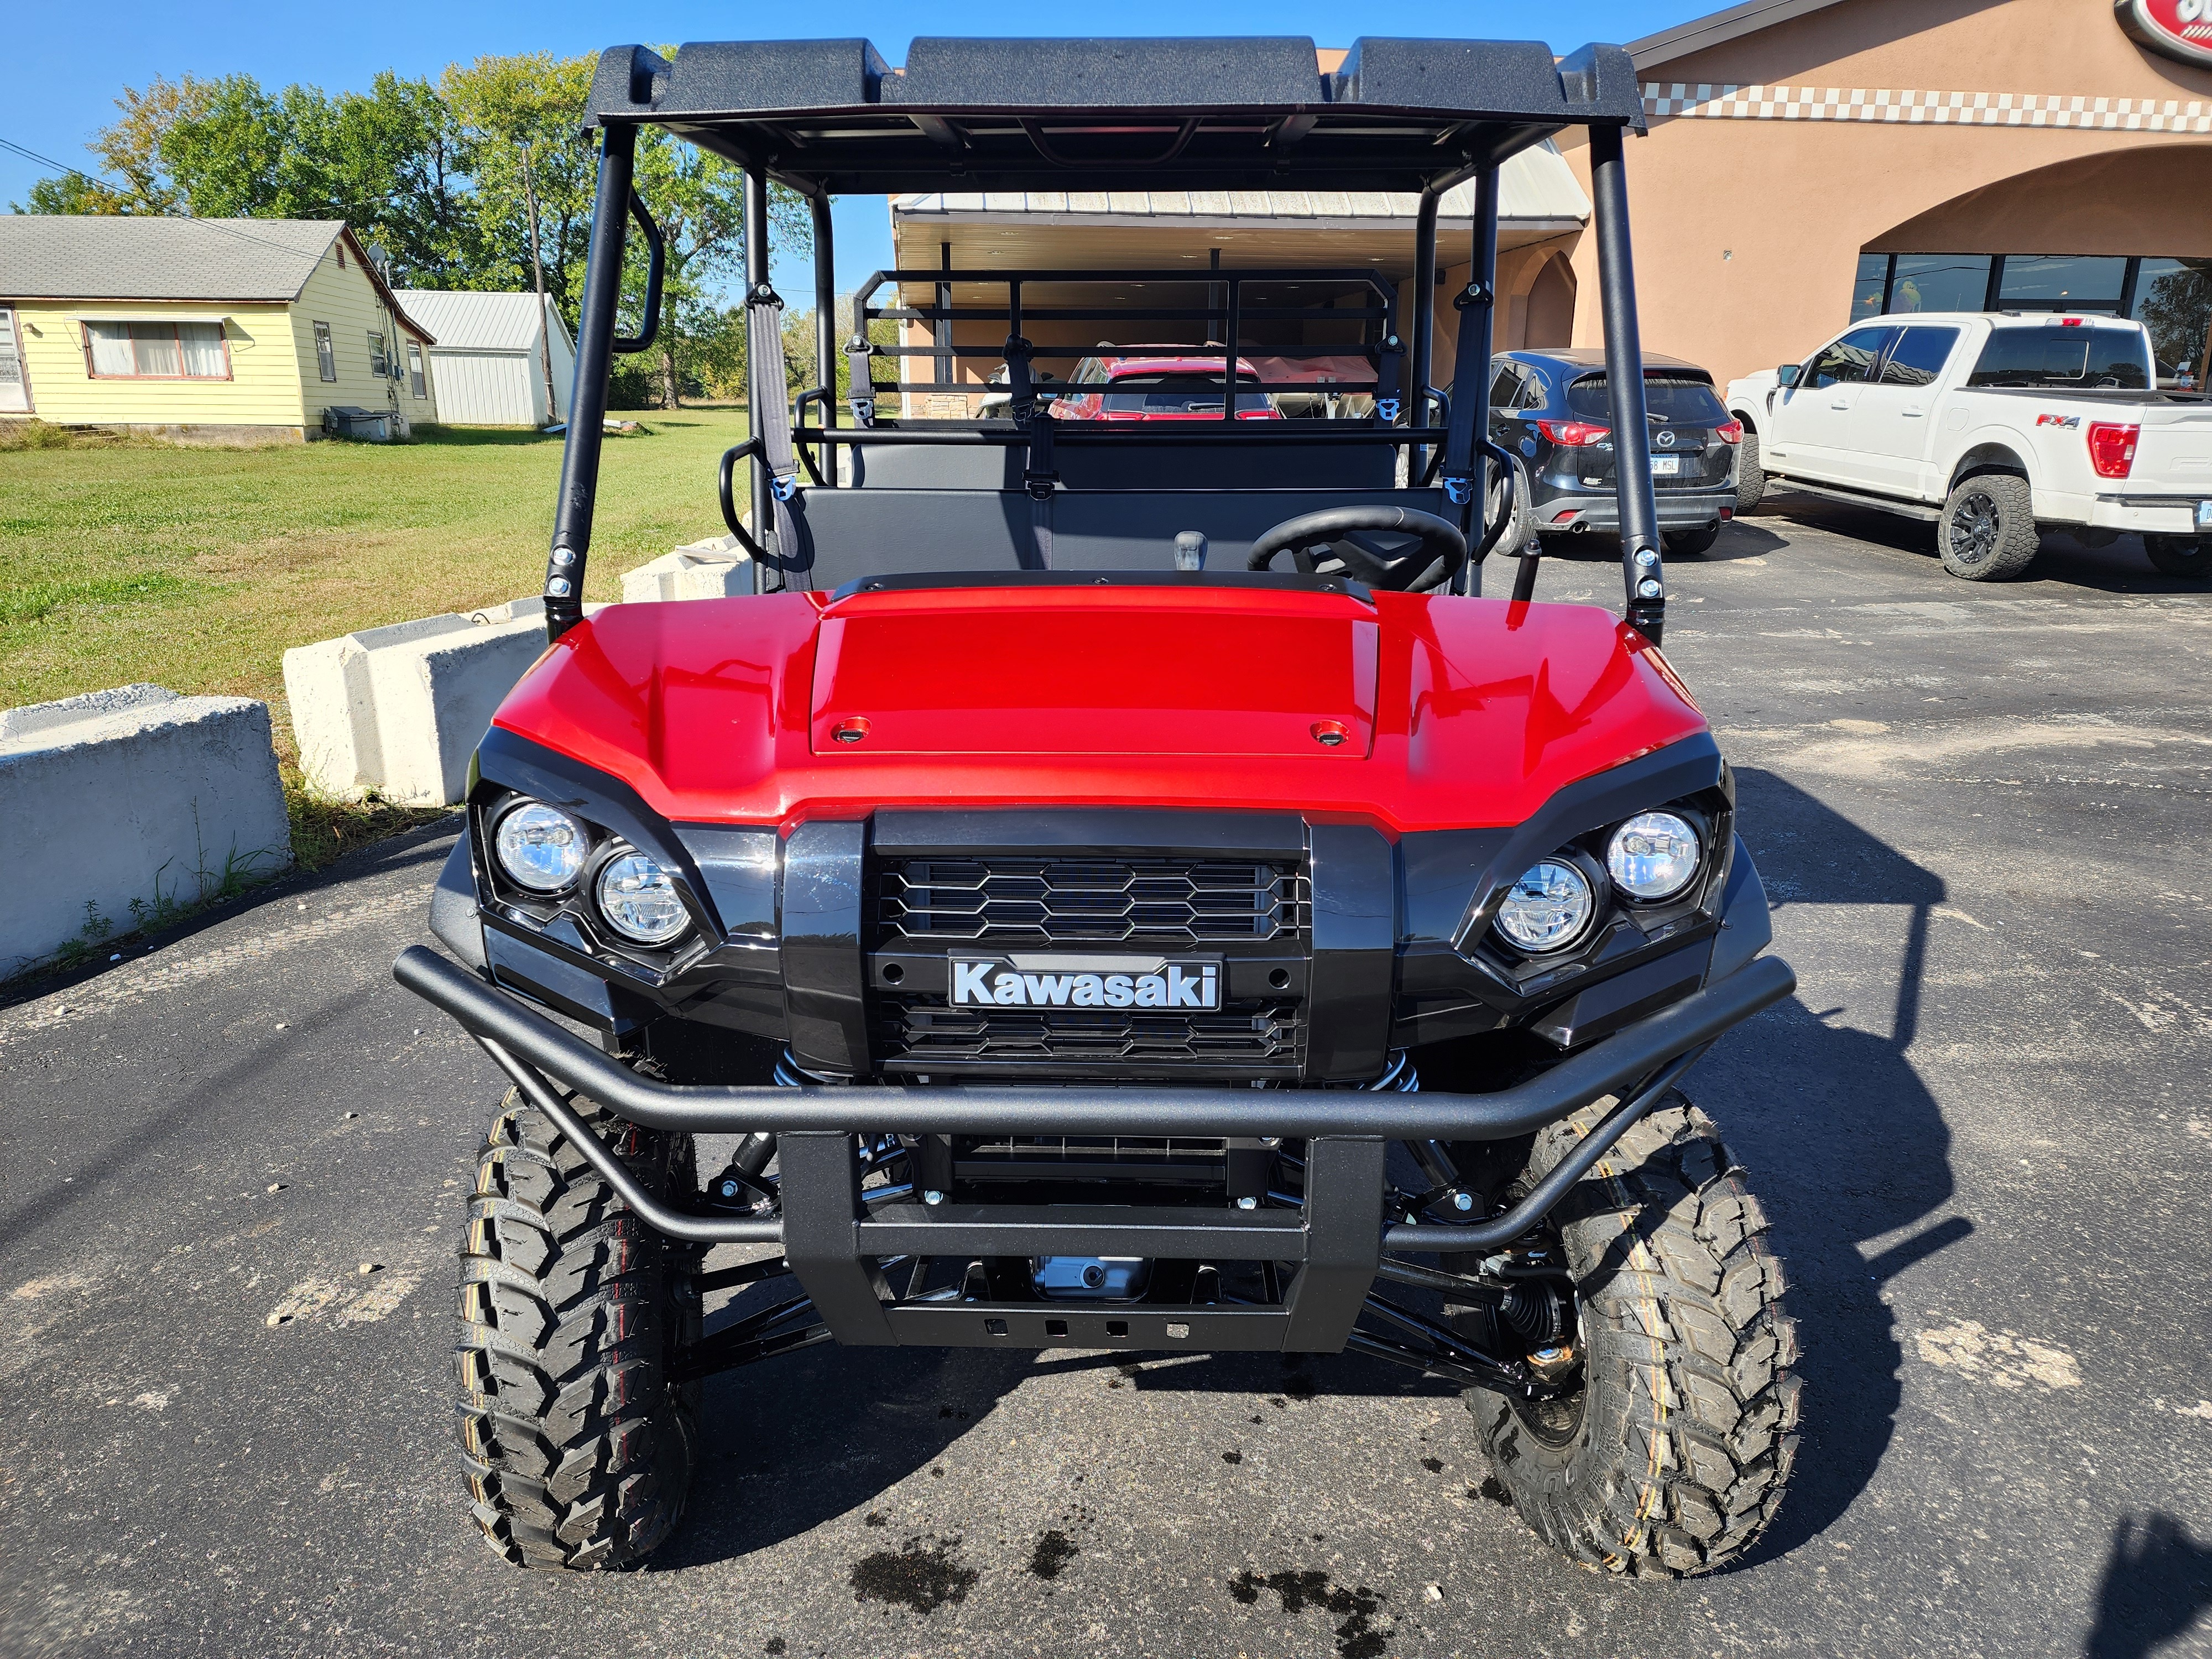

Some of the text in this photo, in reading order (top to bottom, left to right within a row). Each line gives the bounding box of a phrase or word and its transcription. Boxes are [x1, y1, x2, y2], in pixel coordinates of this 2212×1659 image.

[2036, 414, 2080, 427] FX4
[1662, 460, 1676, 470] MSL
[954, 963, 1216, 1007] Kawasaki
